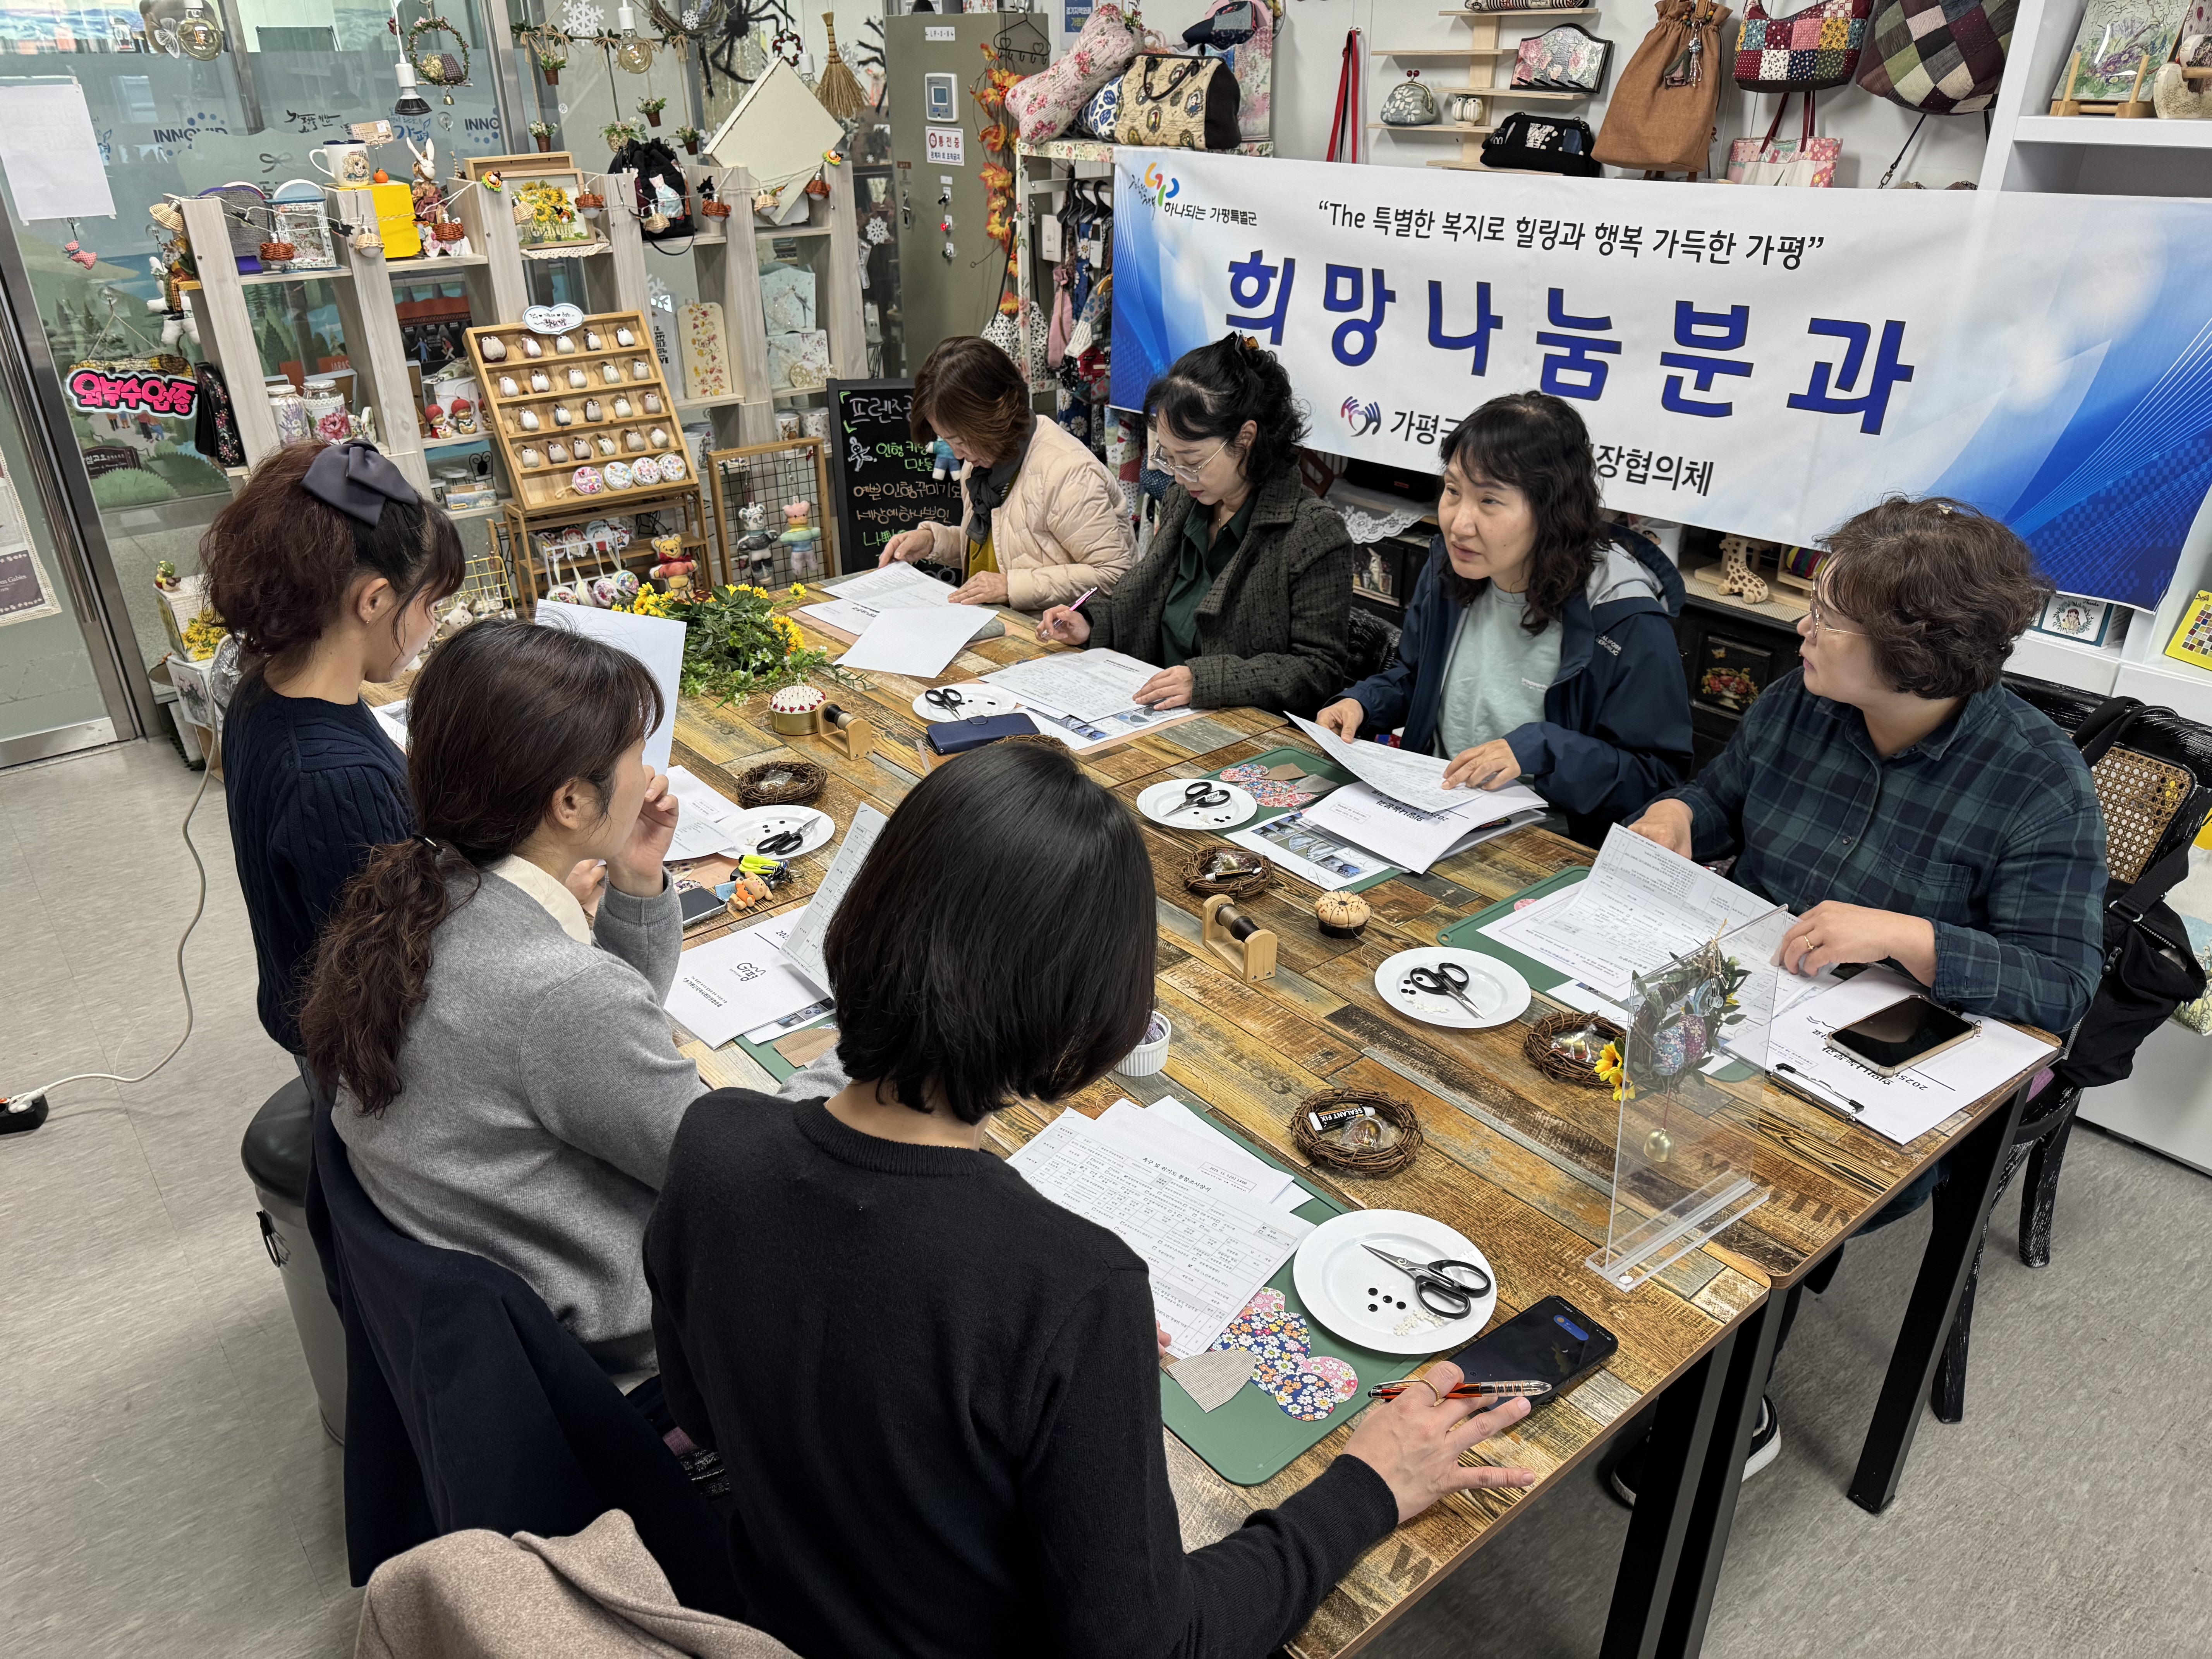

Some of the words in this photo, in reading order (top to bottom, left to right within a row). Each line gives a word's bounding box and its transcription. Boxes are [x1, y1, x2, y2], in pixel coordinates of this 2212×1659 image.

[1164, 202, 1206, 220] 하나되는
[1210, 207, 1257, 226] 가평특별군
[1373, 206, 1435, 239] 특별한
[1442, 212, 1505, 242] 복지로
[1516, 216, 1586, 251] 힐링과
[1595, 222, 1643, 258] 행복
[1652, 229, 1737, 264] 가득한
[72, 373, 195, 414] 외부수업중
[1333, 1108, 1363, 1120] SEALANT
